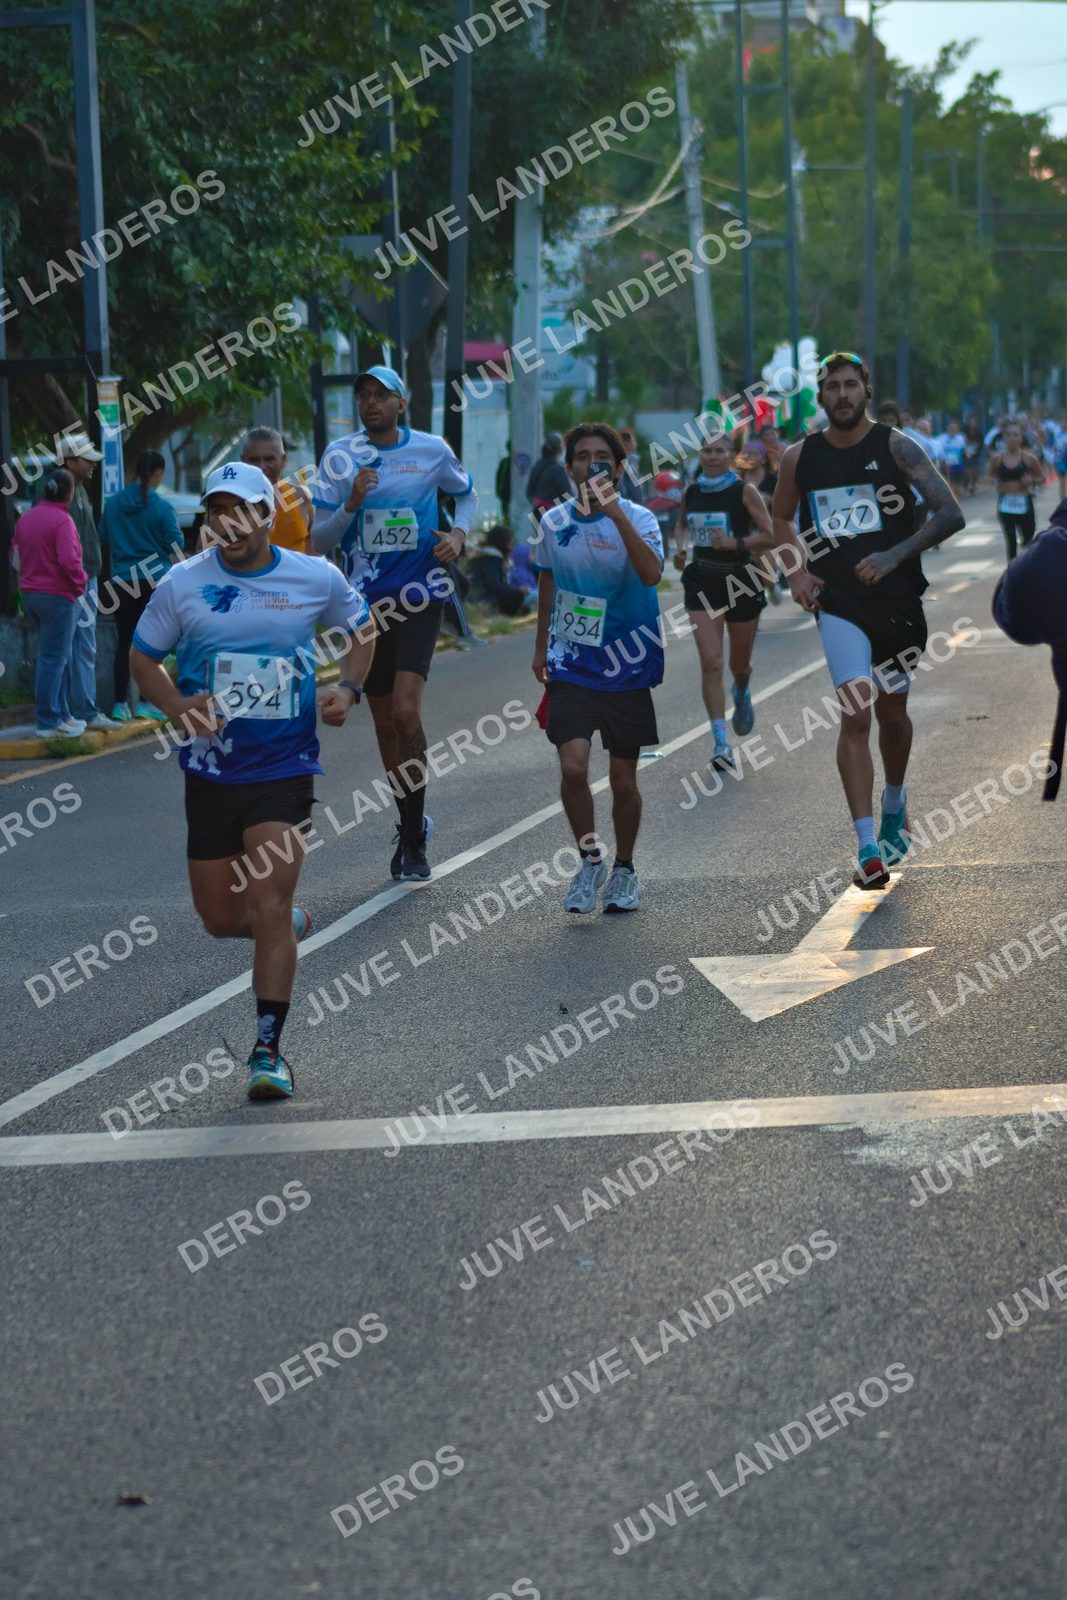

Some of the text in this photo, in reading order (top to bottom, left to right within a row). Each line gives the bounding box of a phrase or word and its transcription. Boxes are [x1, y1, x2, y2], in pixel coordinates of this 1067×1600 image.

[222, 466, 237, 480] LA
[828, 505, 868, 529] 677
[372, 527, 412, 546] 452
[250, 589, 288, 598] Carrera
[264, 603, 304, 611] Integridad
[563, 612, 600, 640] 954
[226, 681, 281, 710] 594
